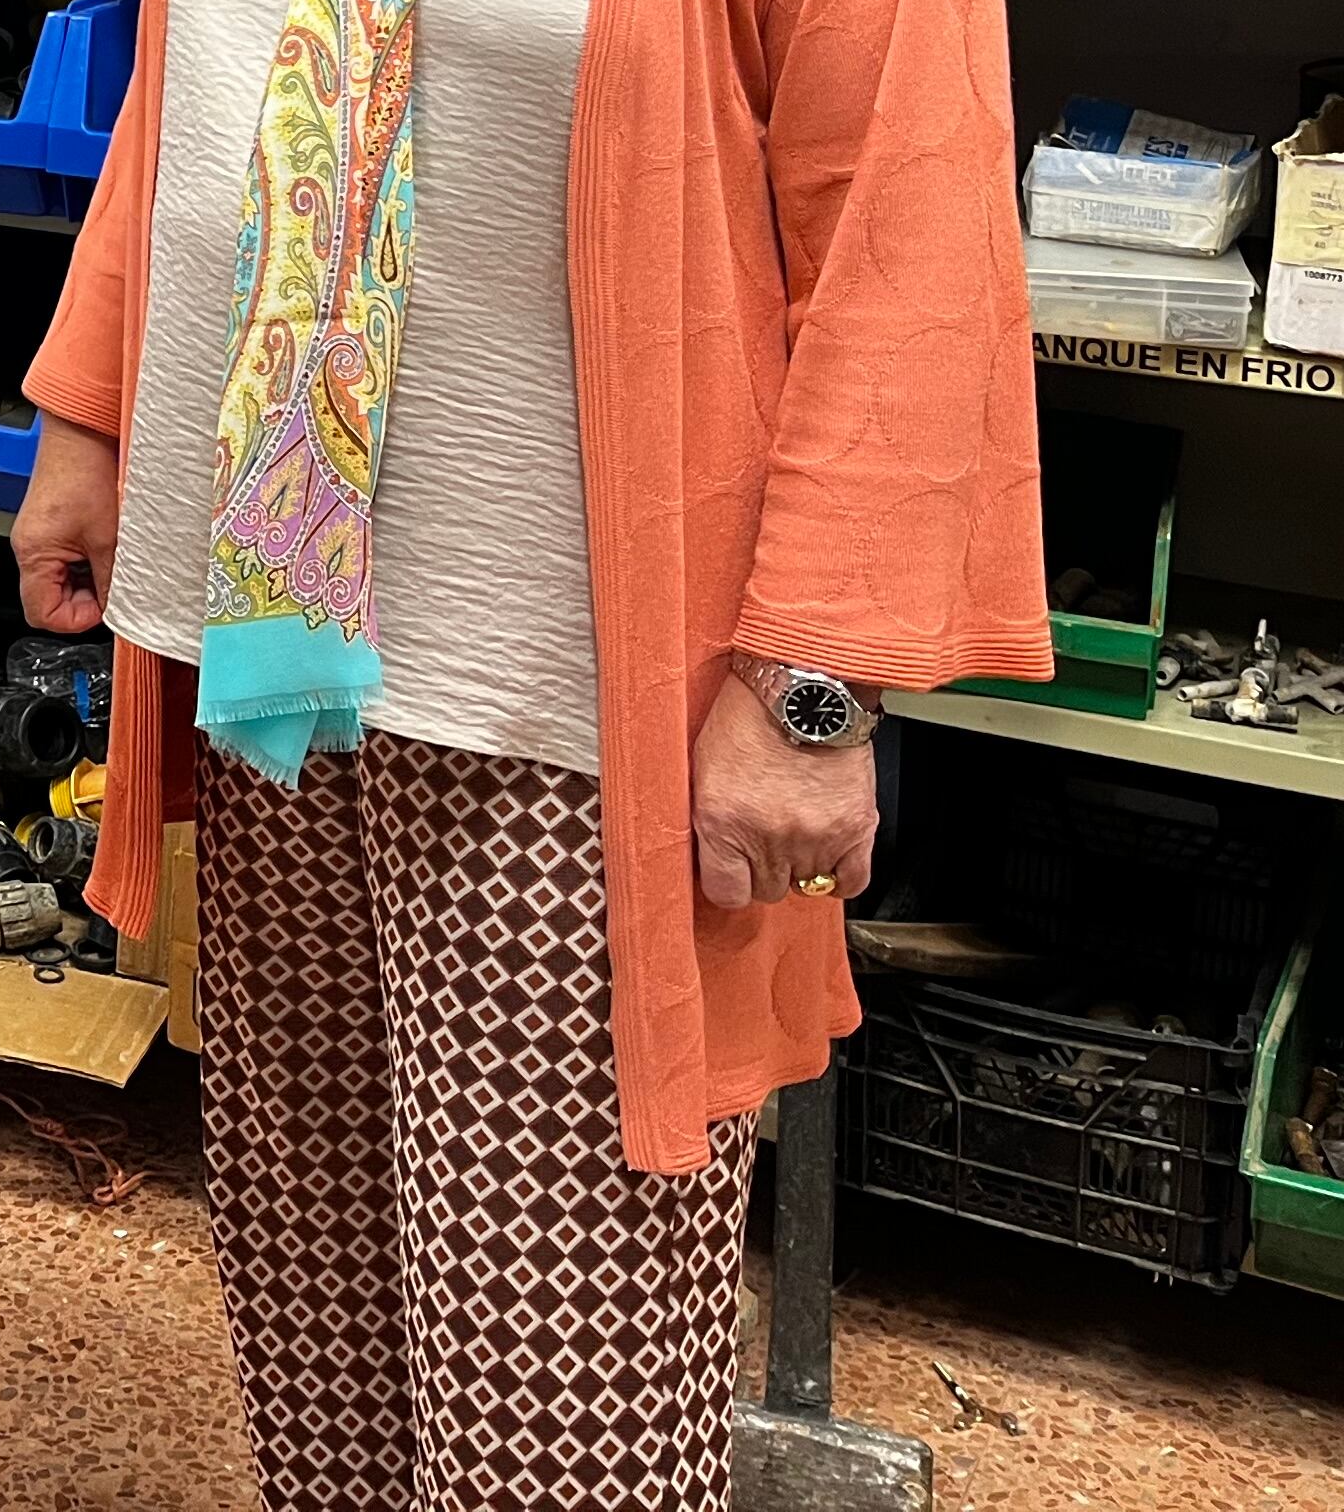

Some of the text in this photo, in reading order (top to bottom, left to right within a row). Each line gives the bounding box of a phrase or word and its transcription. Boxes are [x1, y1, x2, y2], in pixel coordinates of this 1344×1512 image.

[1032, 333, 1336, 392] ANQUE EN FRIO
